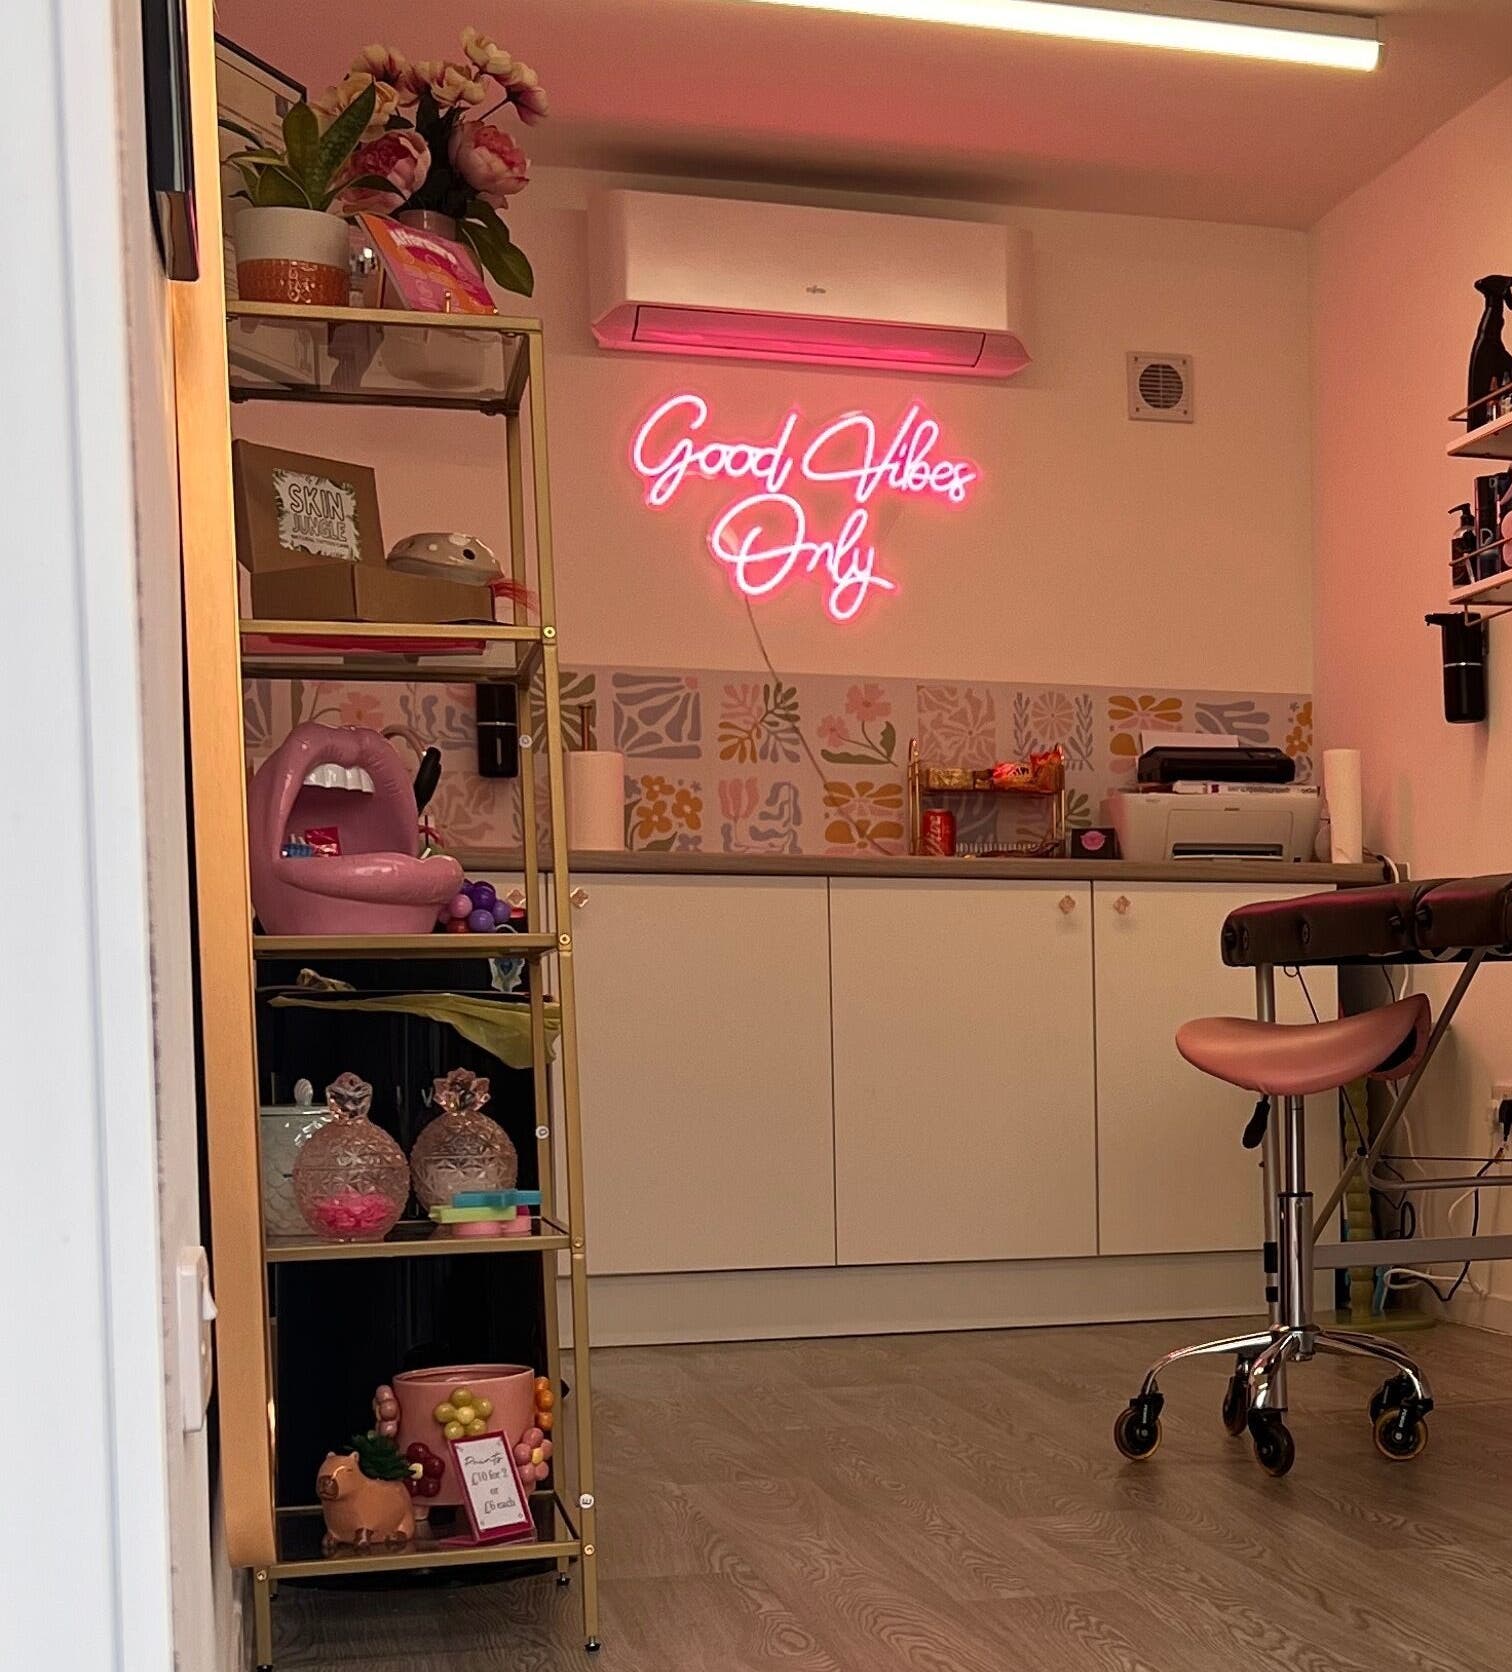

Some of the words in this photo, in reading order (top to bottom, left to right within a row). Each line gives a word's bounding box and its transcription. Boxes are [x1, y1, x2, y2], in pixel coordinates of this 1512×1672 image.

[634, 394, 798, 506] Good
[802, 404, 977, 503] Vibes
[289, 483, 344, 521] SKIN
[292, 513, 346, 542] JUNGLE
[711, 493, 895, 620] Only
